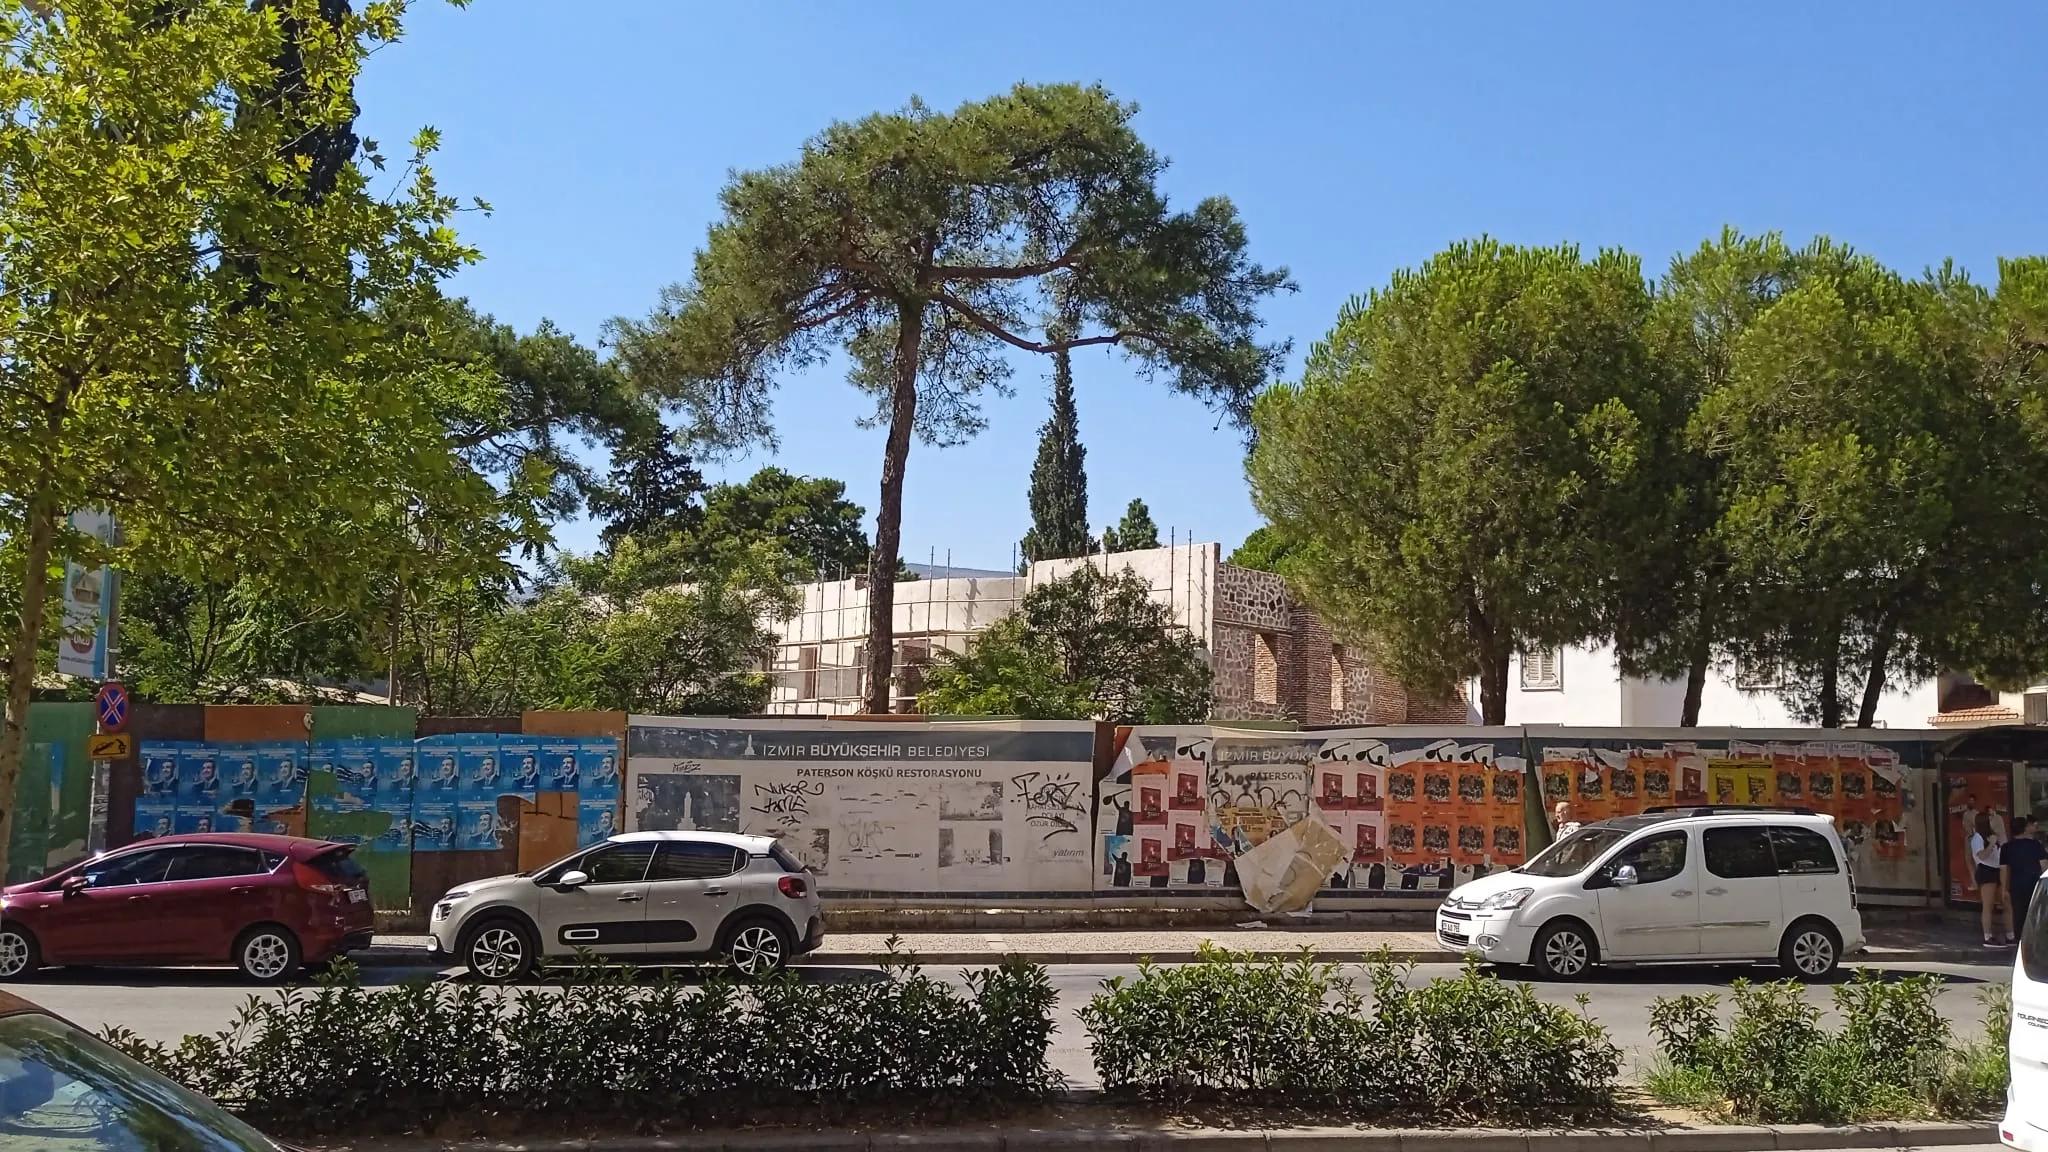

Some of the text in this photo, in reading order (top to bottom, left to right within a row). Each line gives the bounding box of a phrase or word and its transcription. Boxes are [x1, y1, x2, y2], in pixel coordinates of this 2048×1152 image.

[810, 742, 901, 758] BÜYÜKŞEHİR
[908, 745, 990, 757] BELEDİYESİ
[797, 767, 982, 778] PATERSON KÖŞKÜ RESTORASYONU
